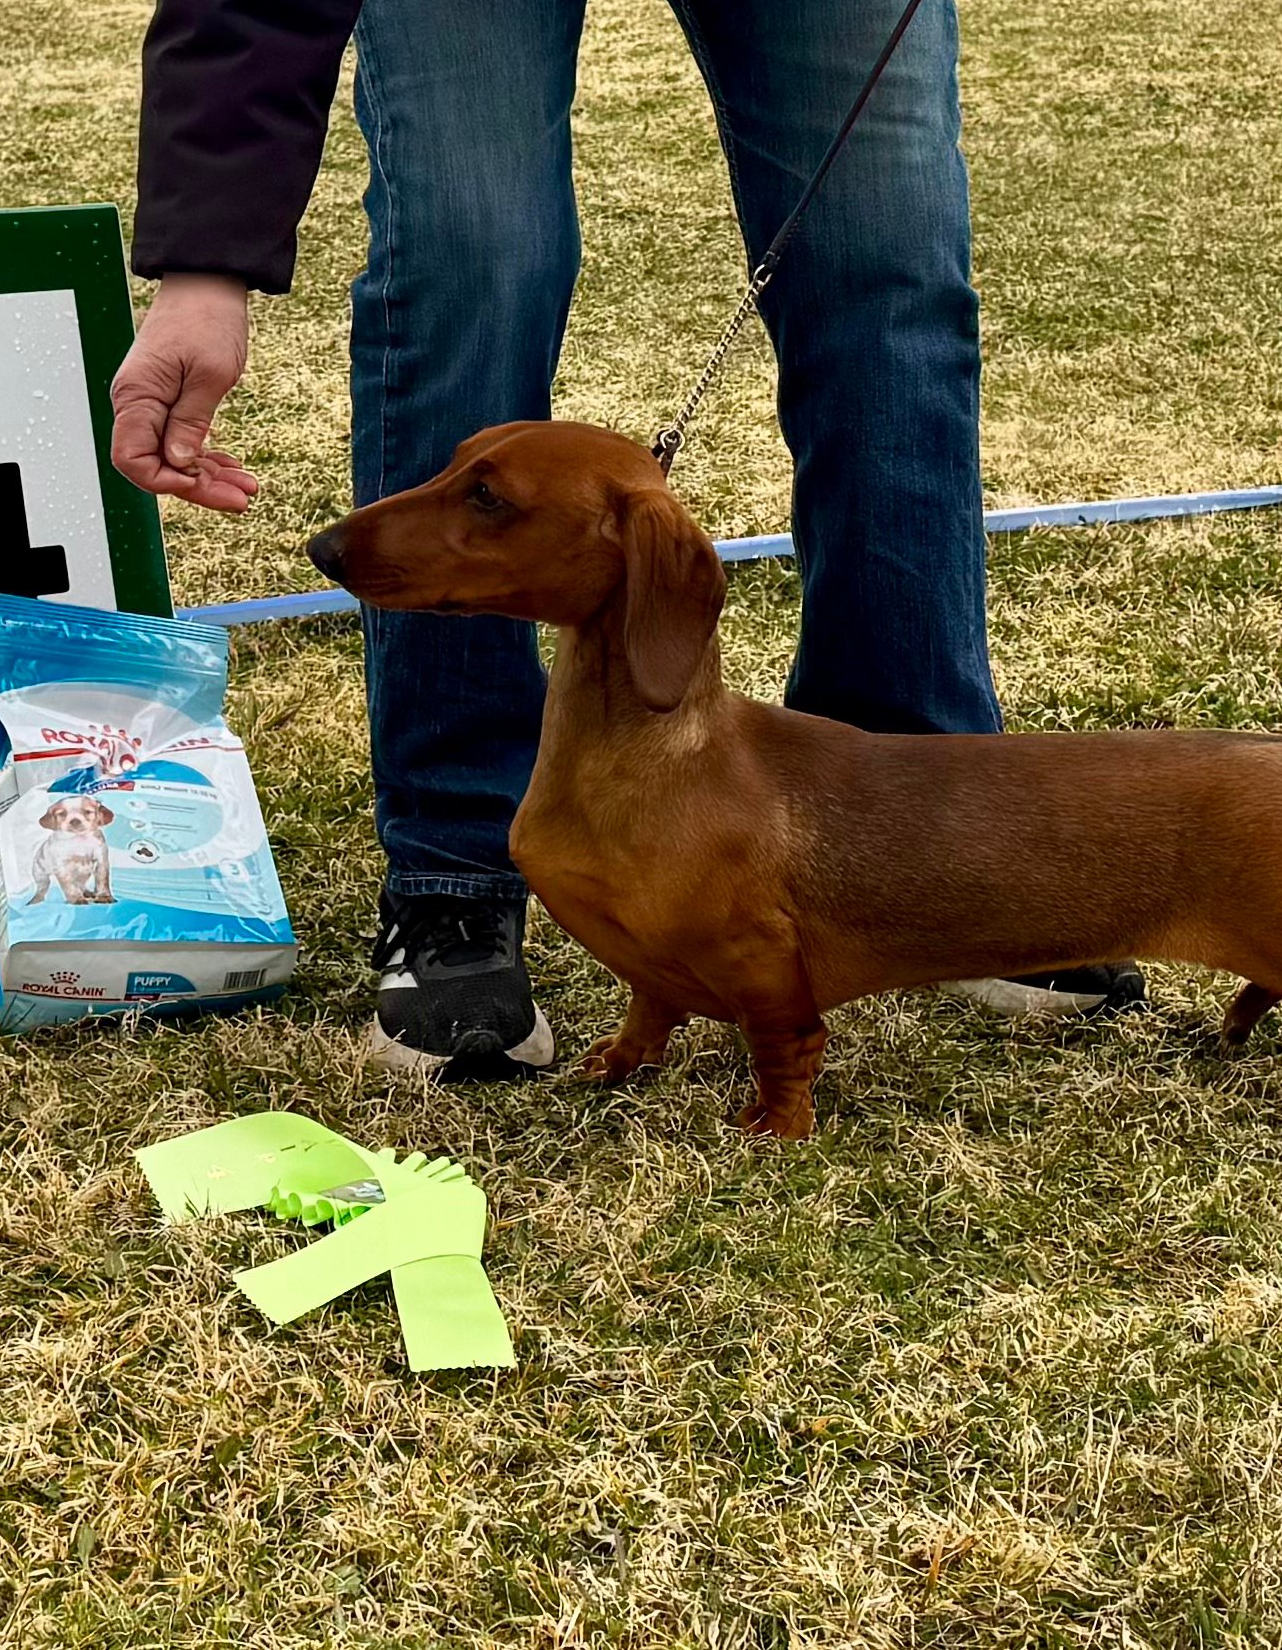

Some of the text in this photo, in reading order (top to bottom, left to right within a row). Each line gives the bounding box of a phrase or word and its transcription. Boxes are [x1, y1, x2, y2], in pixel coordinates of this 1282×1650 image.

[134, 976, 172, 987] PUPPY
[22, 983, 104, 998] ROYAL CANIN
